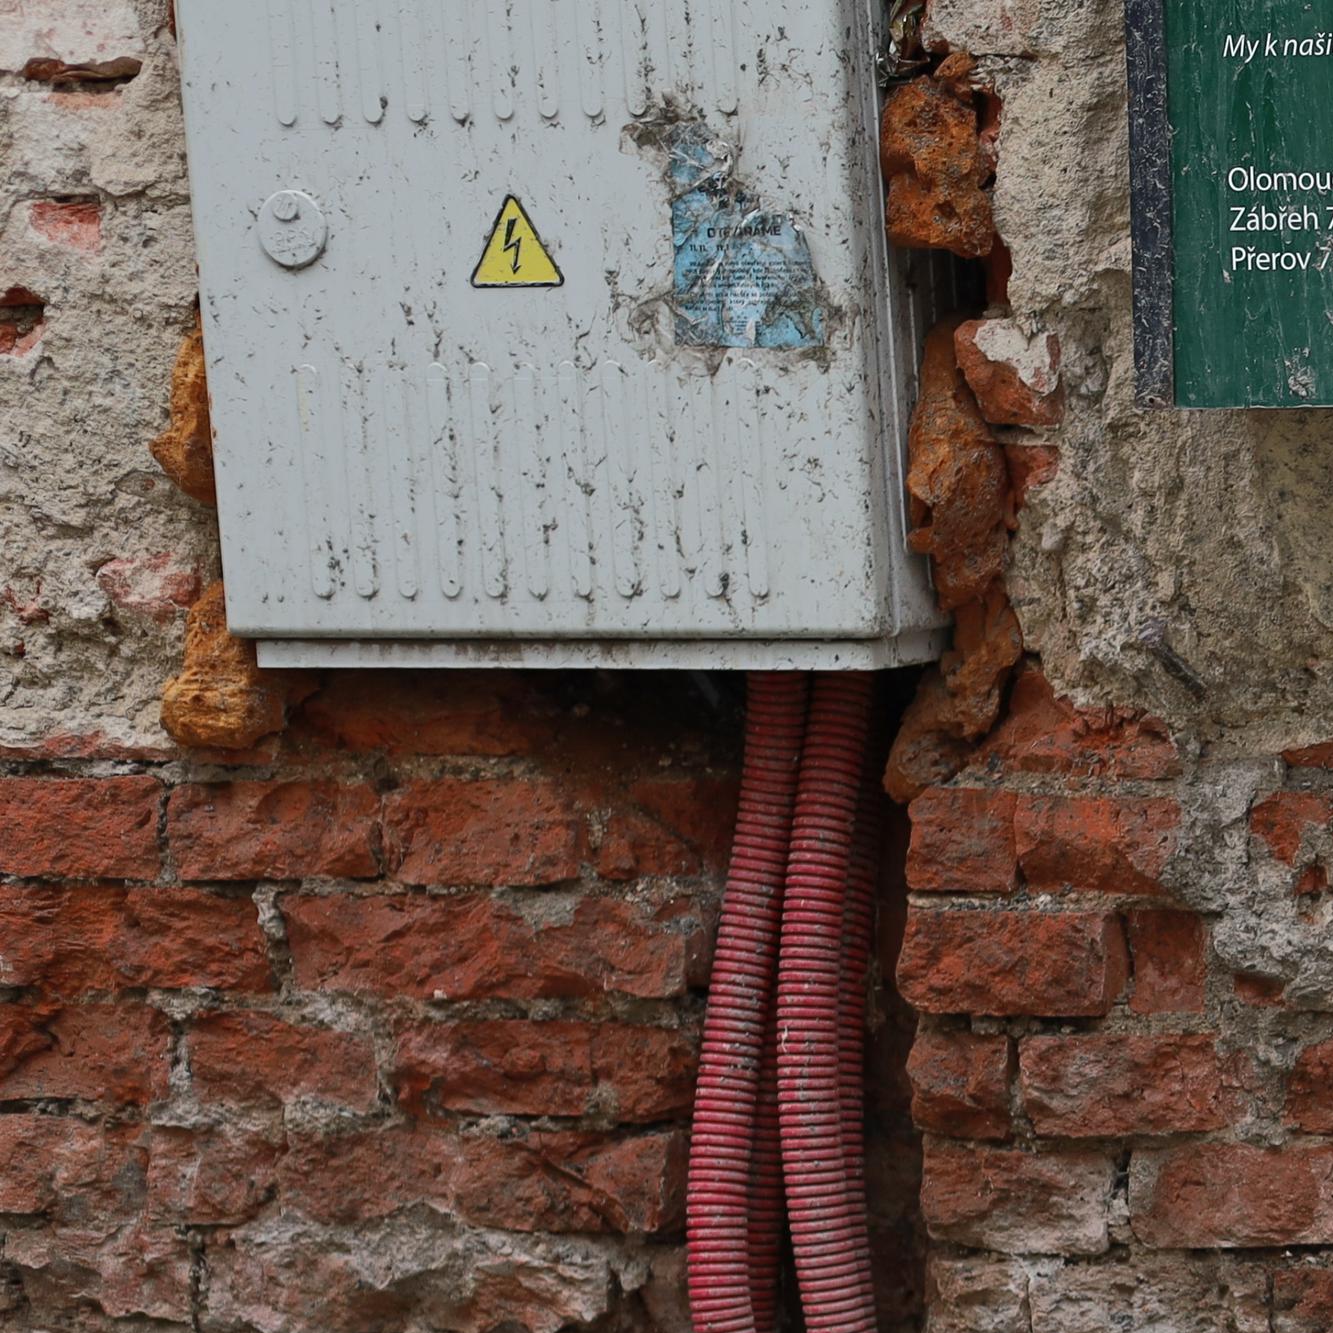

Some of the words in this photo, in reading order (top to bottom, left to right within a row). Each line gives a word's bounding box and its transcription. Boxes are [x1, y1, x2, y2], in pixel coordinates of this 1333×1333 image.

[1223, 34, 1259, 63] My
[1265, 33, 1278, 56] k
[1230, 205, 1318, 231] Zábřeh
[1231, 245, 1311, 271] Přerov
